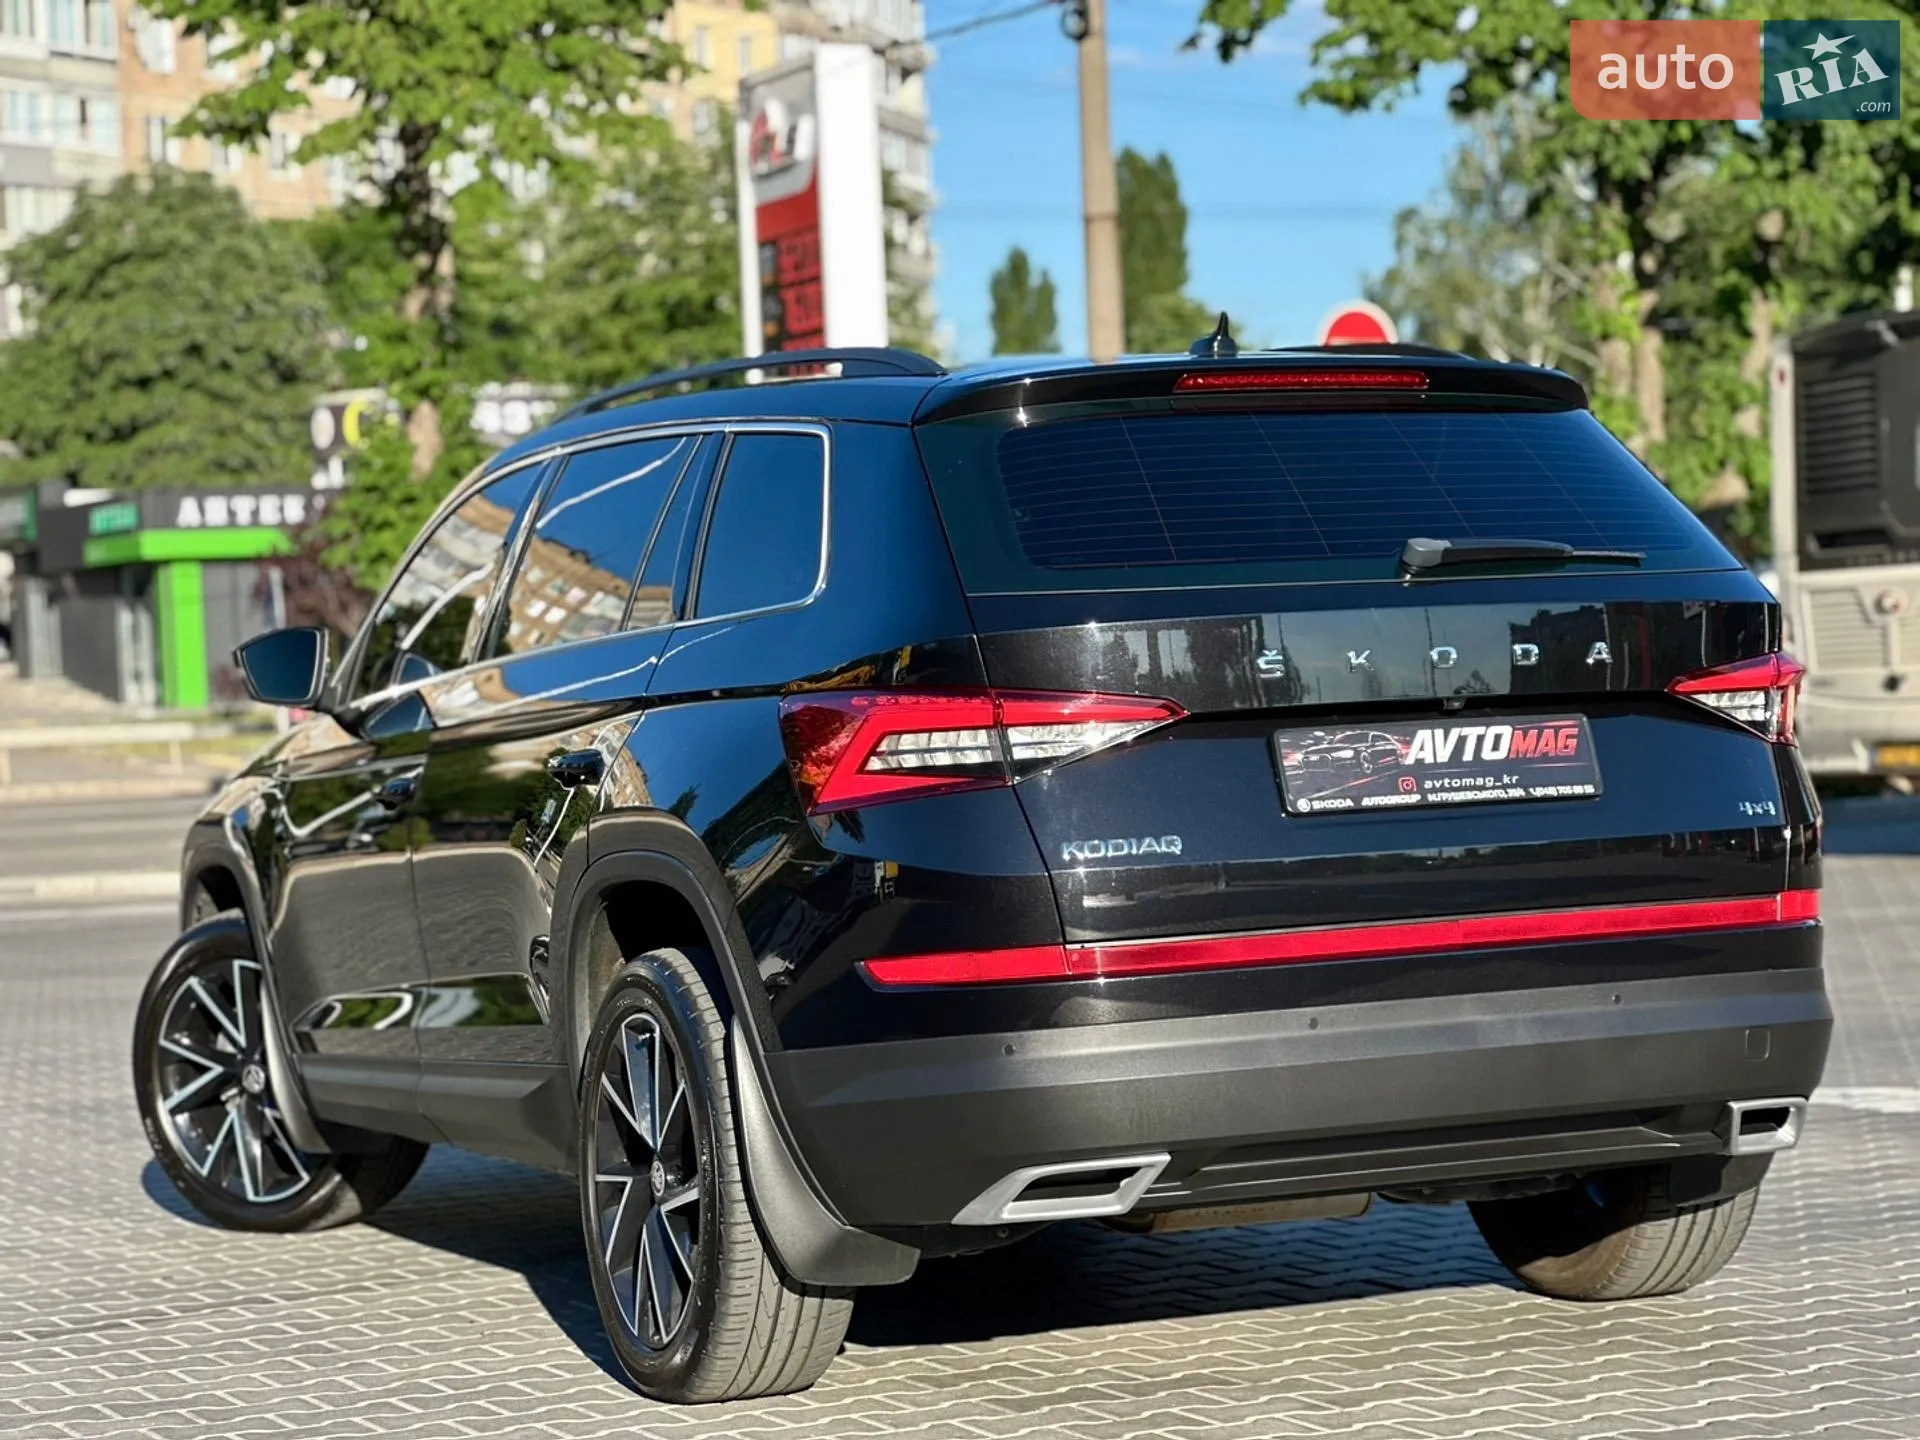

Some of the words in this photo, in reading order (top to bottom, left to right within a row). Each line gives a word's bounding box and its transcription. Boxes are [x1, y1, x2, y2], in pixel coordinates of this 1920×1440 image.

[1404, 725, 1579, 765] AVTOMAG
[1424, 773, 1519, 789] avtomag_kr
[1062, 835, 1183, 861] KODIAQ
